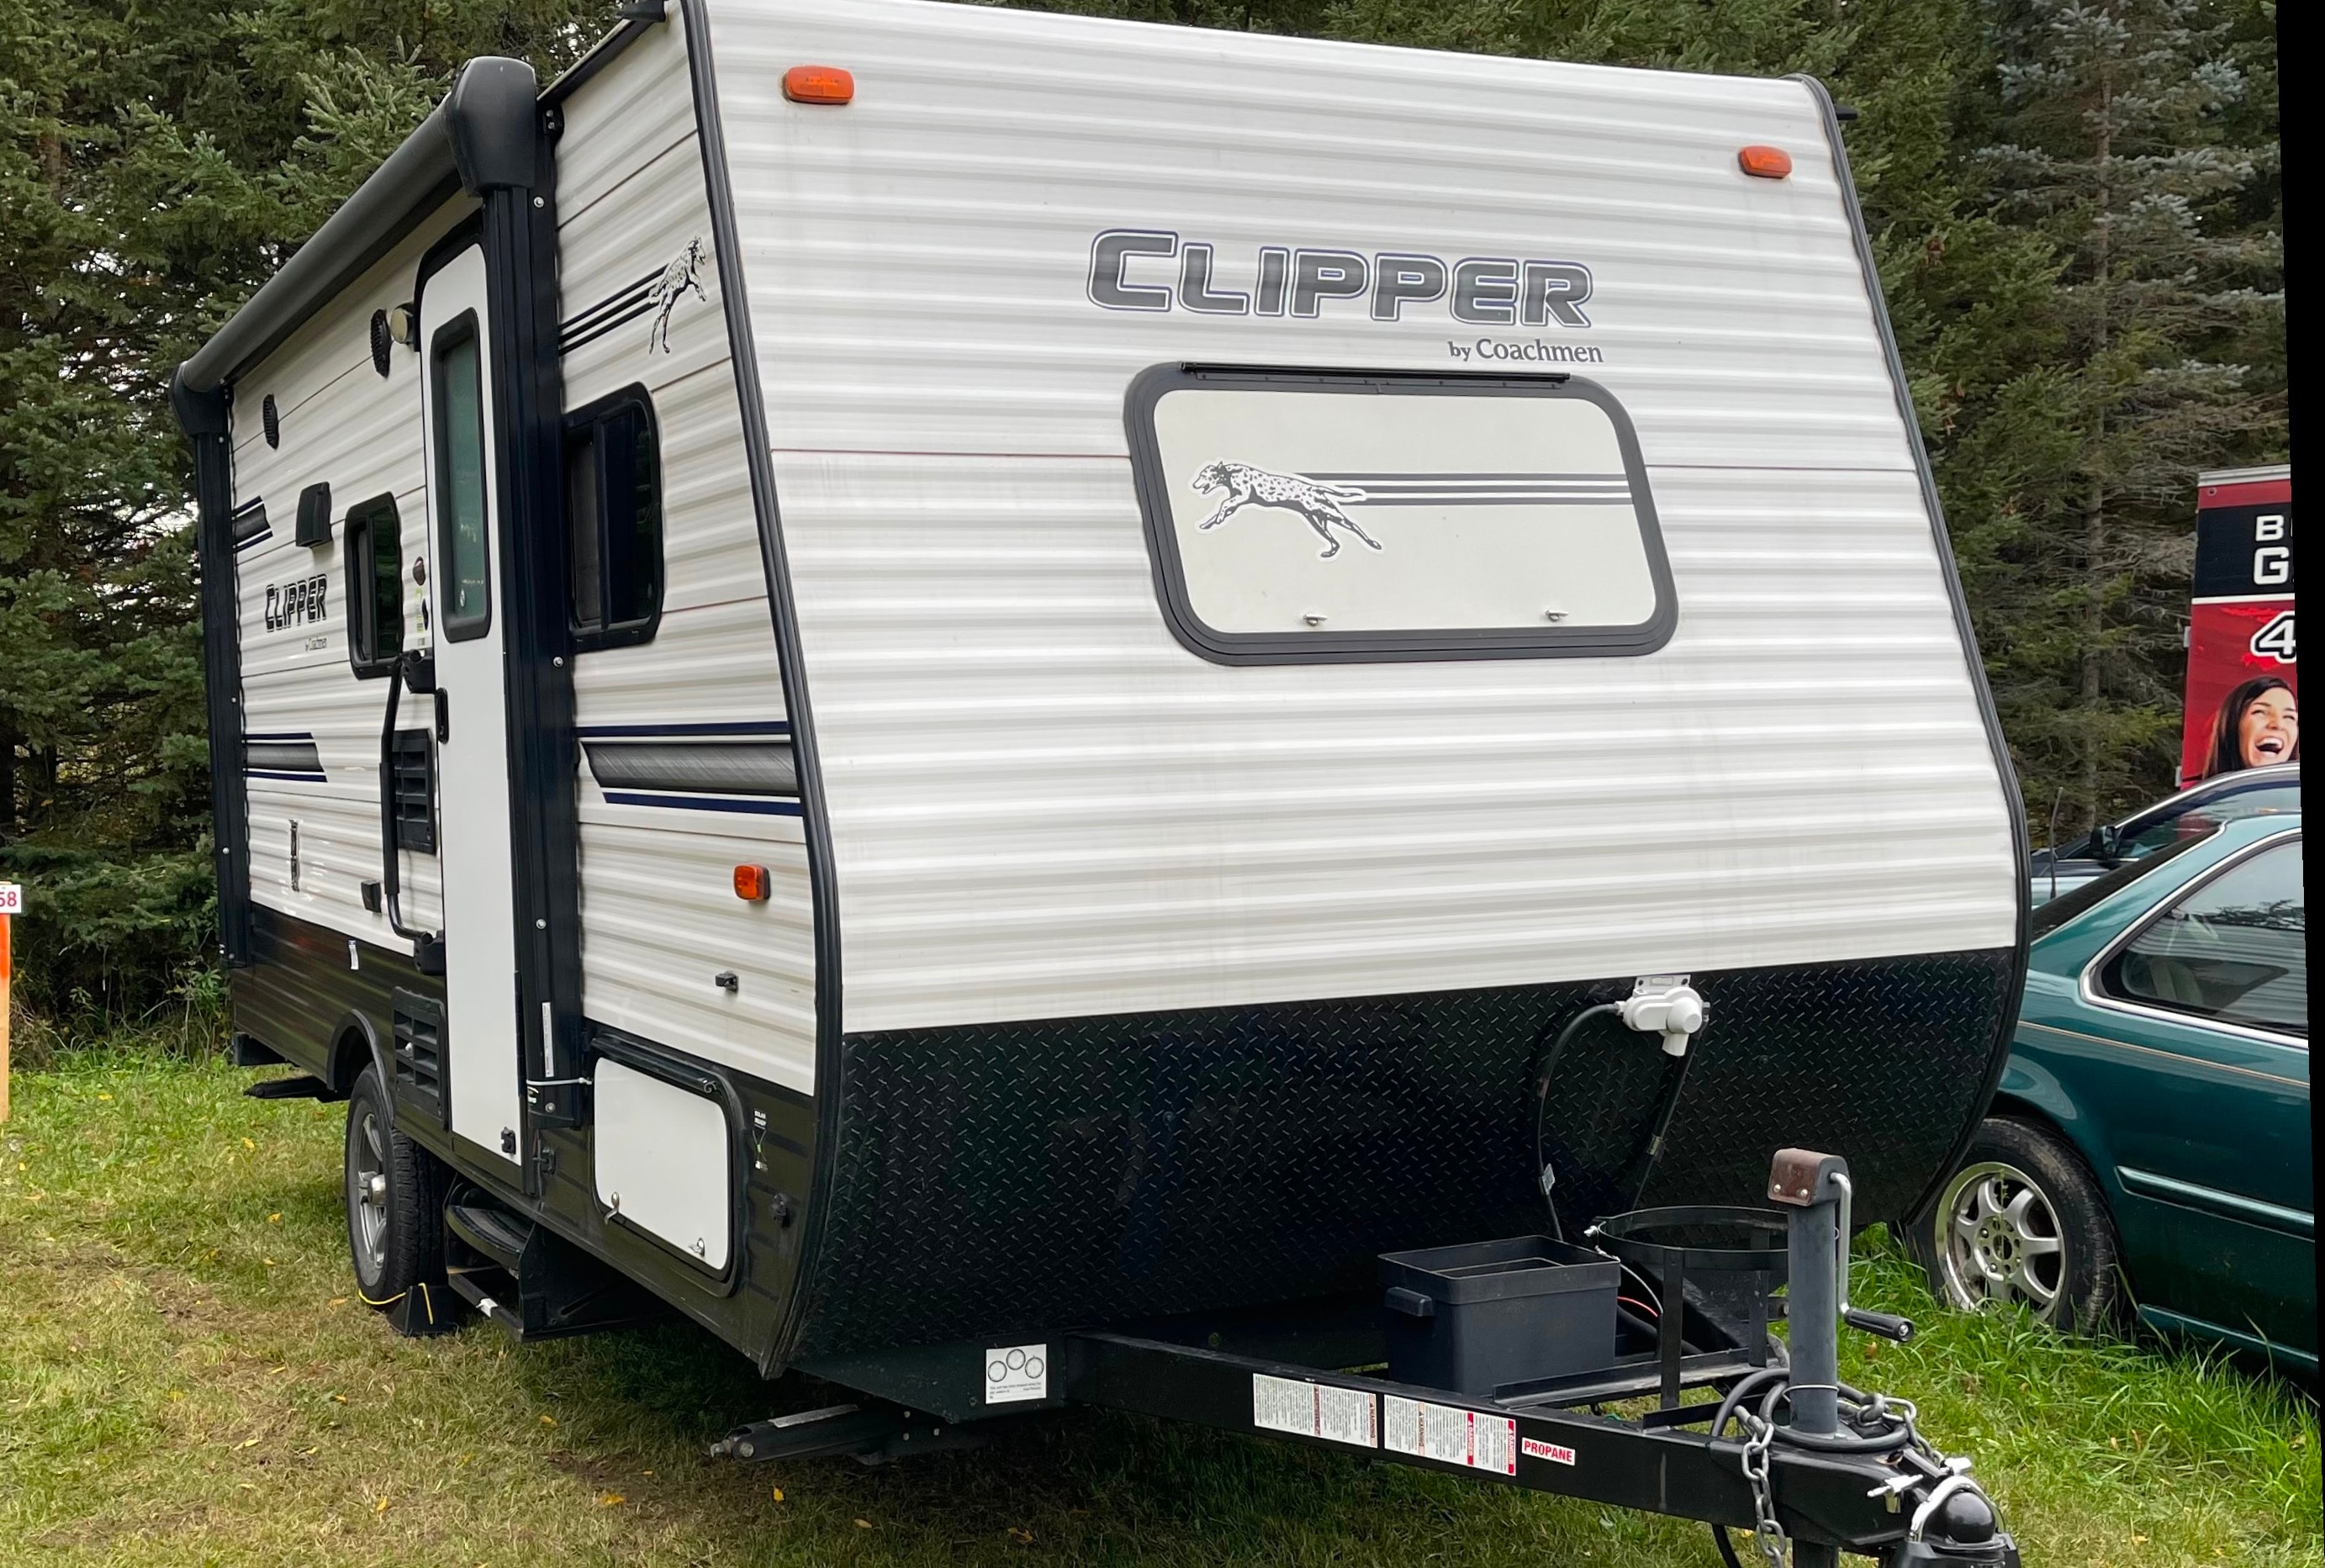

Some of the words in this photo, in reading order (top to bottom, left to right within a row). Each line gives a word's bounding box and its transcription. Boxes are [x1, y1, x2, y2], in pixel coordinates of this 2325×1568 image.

[1086, 228, 1593, 328] CLIPPER
[1447, 341, 1472, 362] by
[1476, 338, 1604, 363] Coachmen
[2255, 515, 2292, 541] B
[2254, 546, 2294, 585] G
[265, 573, 327, 633] CLIPPER
[1524, 1439, 1573, 1463] PROPANE
